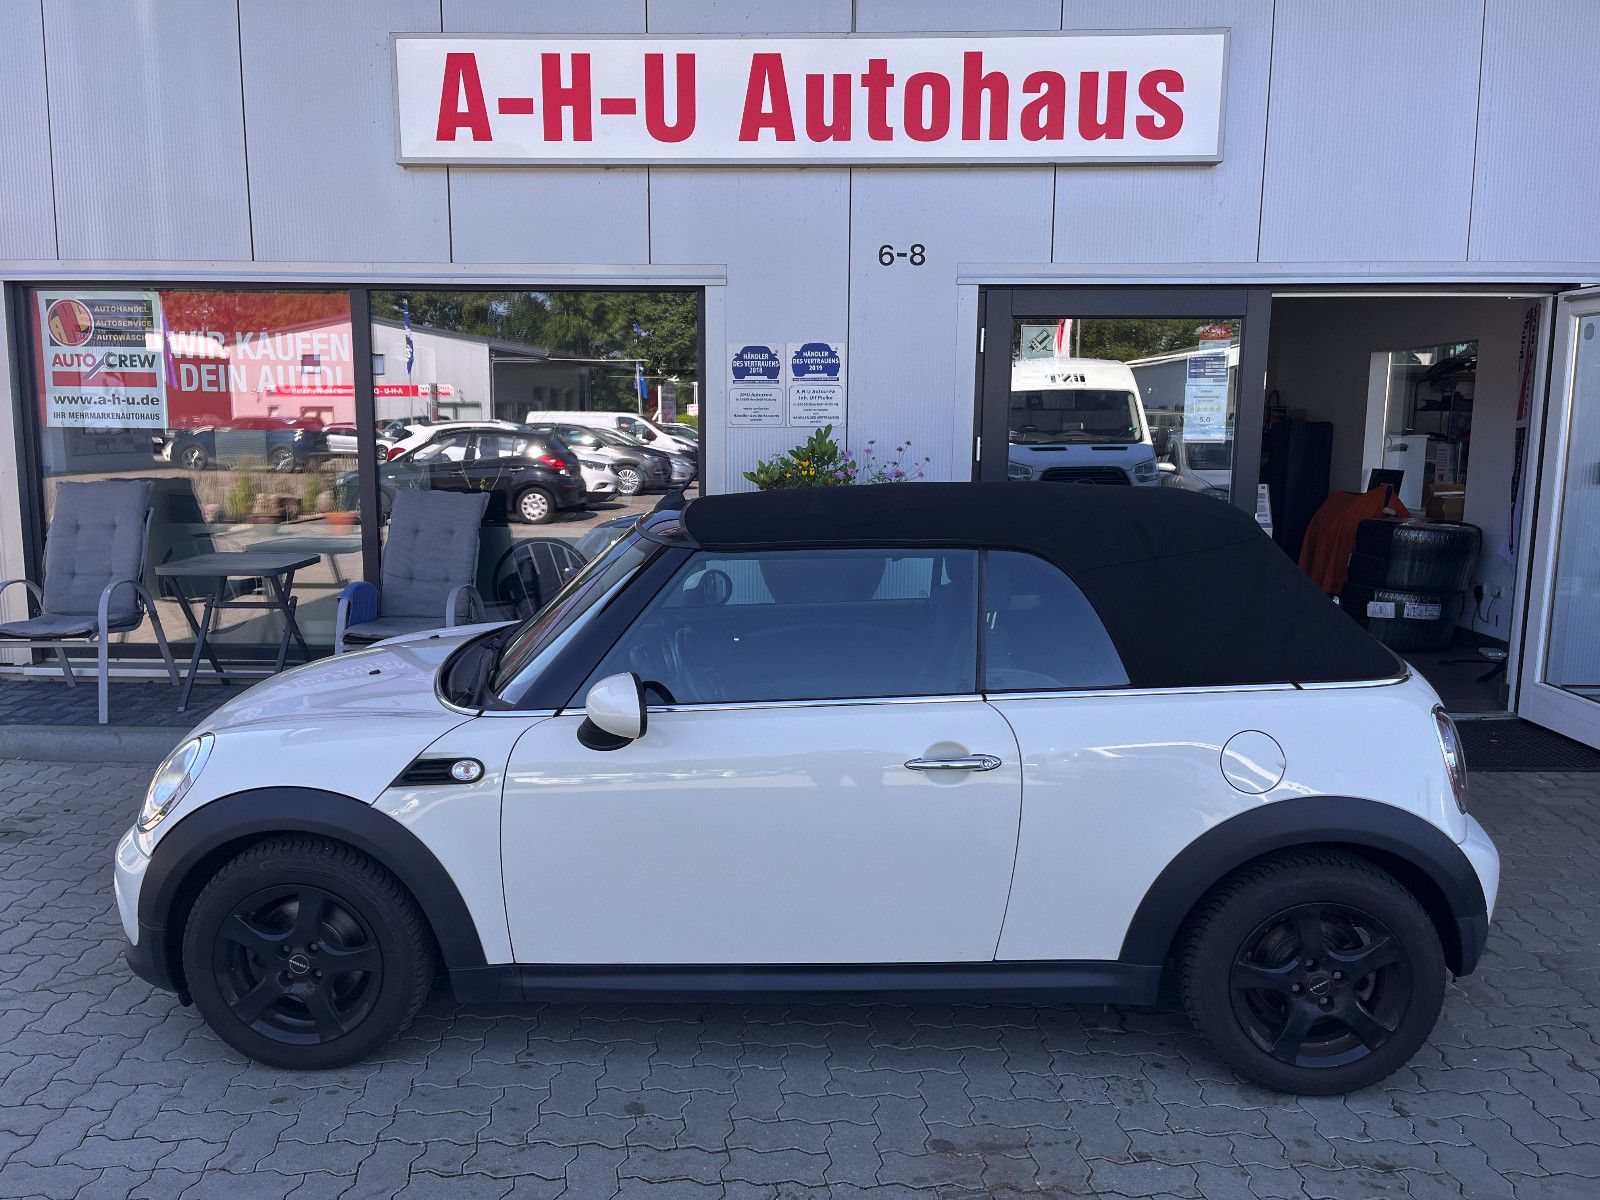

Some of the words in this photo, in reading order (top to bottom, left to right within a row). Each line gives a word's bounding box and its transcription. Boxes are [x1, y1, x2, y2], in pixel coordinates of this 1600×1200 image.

[436, 52, 696, 143] A-H-U
[738, 51, 1185, 143] Autohaus
[878, 243, 926, 267] 6-8
[94, 305, 149, 313] AUTOHANDEL
[169, 331, 226, 359] WIR
[236, 331, 350, 361] KAUFEN
[52, 353, 97, 367] AUTO
[104, 353, 156, 368] CREW
[743, 352, 769, 360] HÄNDLER
[179, 363, 248, 392] DEIN
[257, 364, 343, 393] AUTO!
[54, 394, 160, 406] www.a-h-u.de
[53, 411, 66, 419] IHR
[68, 412, 160, 421] MEHRMARKENAUTOHAUS
